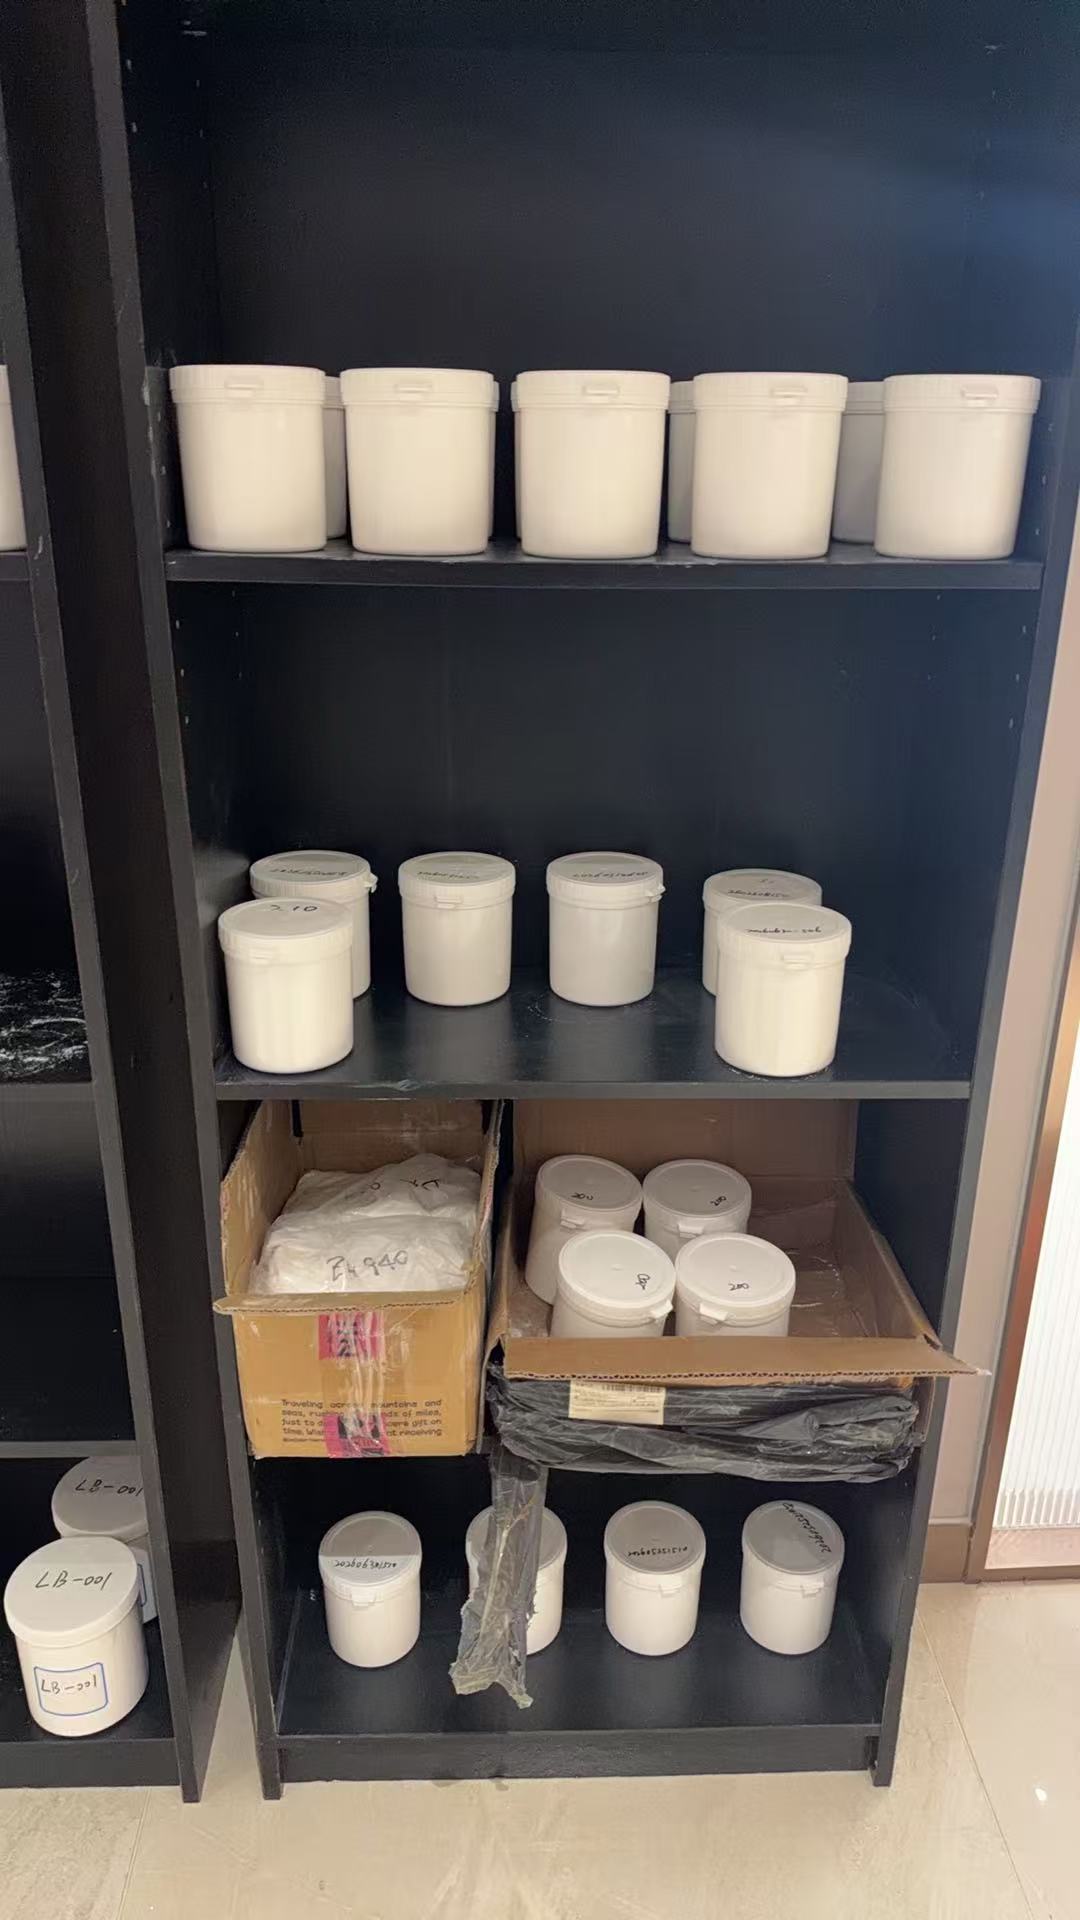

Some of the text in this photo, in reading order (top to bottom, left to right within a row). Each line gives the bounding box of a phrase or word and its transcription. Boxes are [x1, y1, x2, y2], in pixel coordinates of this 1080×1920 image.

[281, 1399, 323, 1409] Traveling
[424, 1398, 442, 1408] and
[34, 1570, 113, 1591] LB-001
